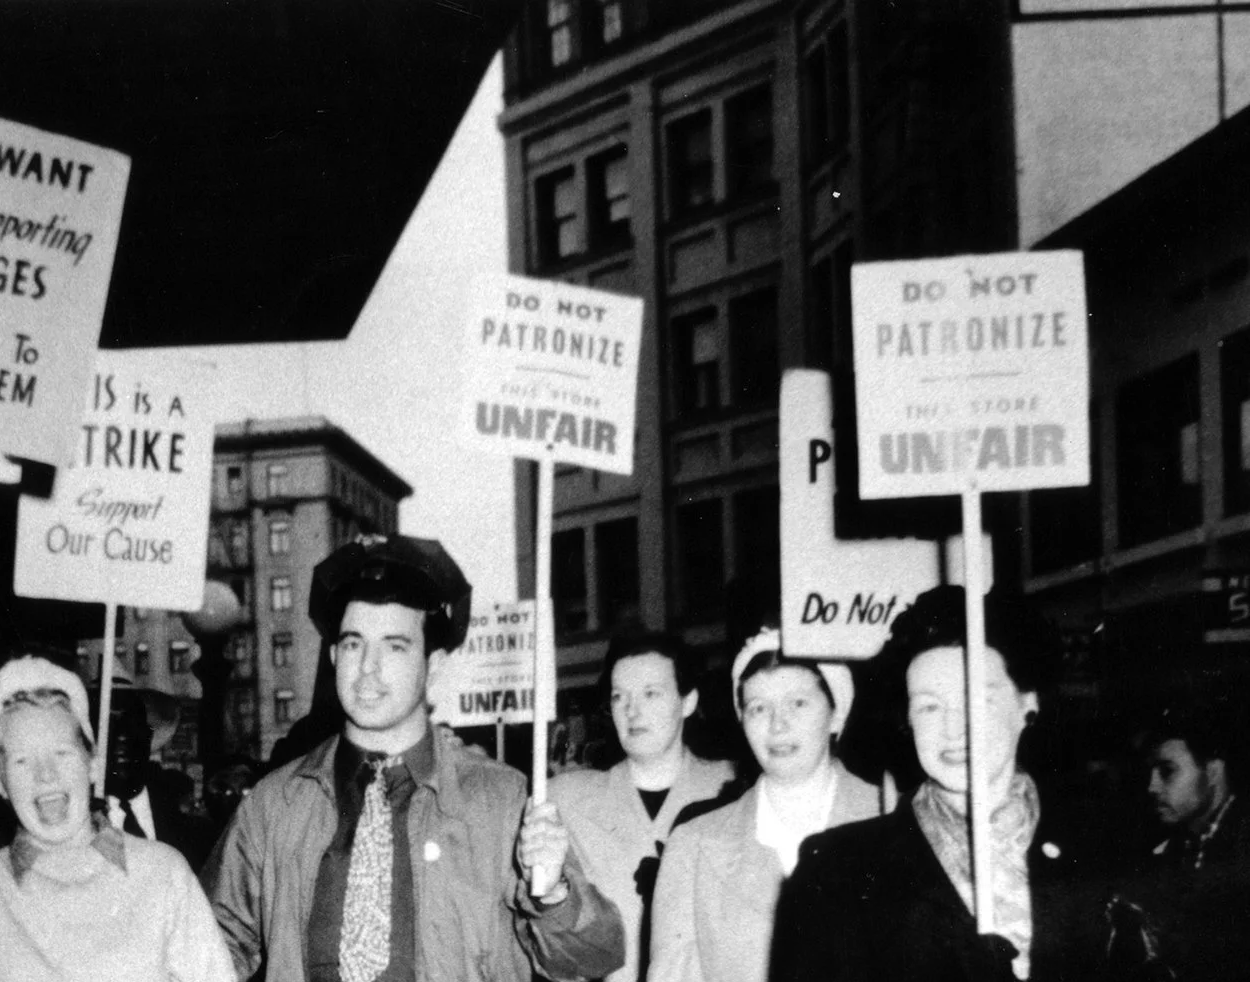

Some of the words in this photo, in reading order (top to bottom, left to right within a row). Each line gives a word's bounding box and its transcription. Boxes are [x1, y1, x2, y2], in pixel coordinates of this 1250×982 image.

[506, 291, 540, 312] DO
[557, 298, 607, 323] NOT
[902, 280, 947, 304] DO
[969, 273, 1038, 298] NOT
[14, 333, 39, 365] To
[481, 317, 625, 367] PATRONIZE
[876, 311, 1067, 358] PATRONIZE
[94, 374, 117, 411] IS
[168, 396, 185, 418] A
[476, 401, 617, 455] UNFAIR
[82, 425, 186, 474] TRIKE
[880, 424, 1066, 475] UNFAIR
[77, 487, 164, 525] Support
[46, 523, 93, 556] Our
[104, 527, 173, 565] Cause
[497, 612, 528, 624] NOT
[801, 593, 839, 625] Do
[846, 592, 898, 625] Not
[459, 632, 534, 655] ATRONIZ
